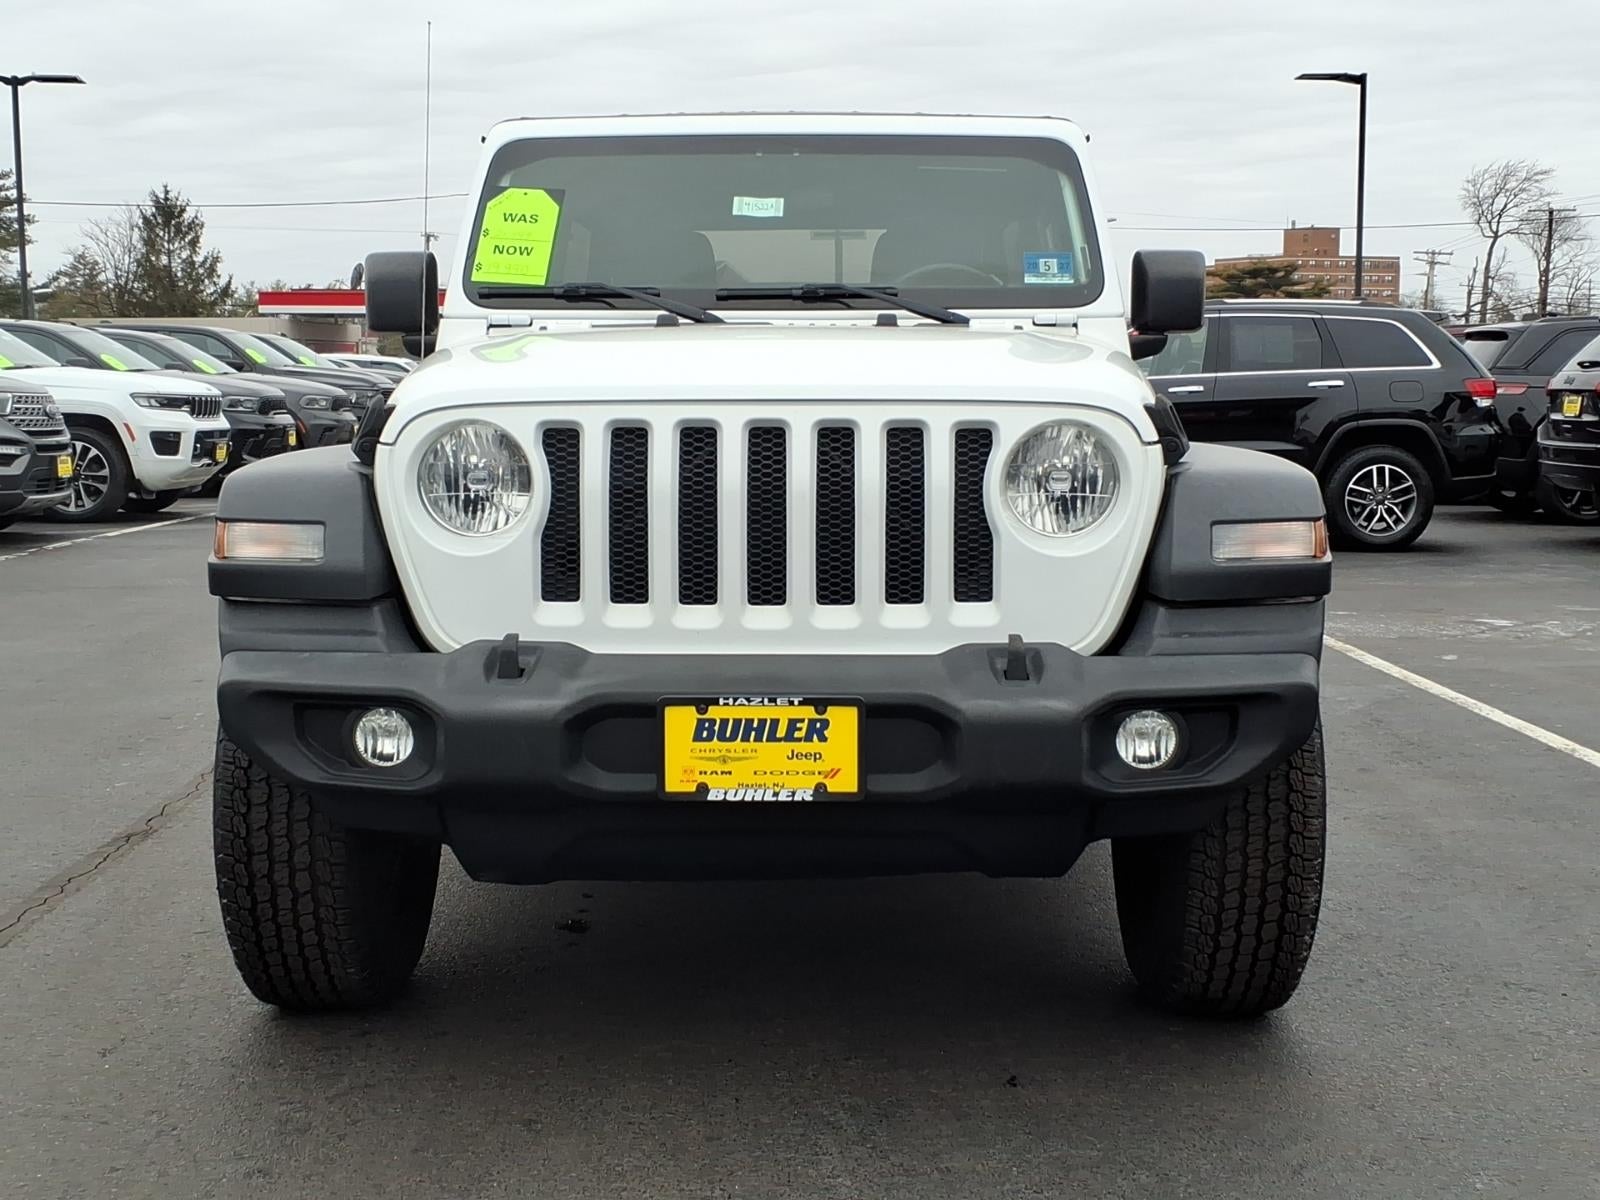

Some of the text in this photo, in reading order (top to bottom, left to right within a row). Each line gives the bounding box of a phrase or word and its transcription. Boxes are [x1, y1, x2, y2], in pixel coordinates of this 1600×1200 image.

[503, 212, 539, 224] WAS
[482, 228, 490, 238] $
[493, 244, 534, 256] NOW
[475, 262, 483, 272] $
[1043, 260, 1051, 272] 5
[719, 697, 803, 706] HAZLET
[692, 717, 831, 743] BUHLER
[786, 748, 823, 763] Jeep
[706, 788, 814, 802] BUHLER
